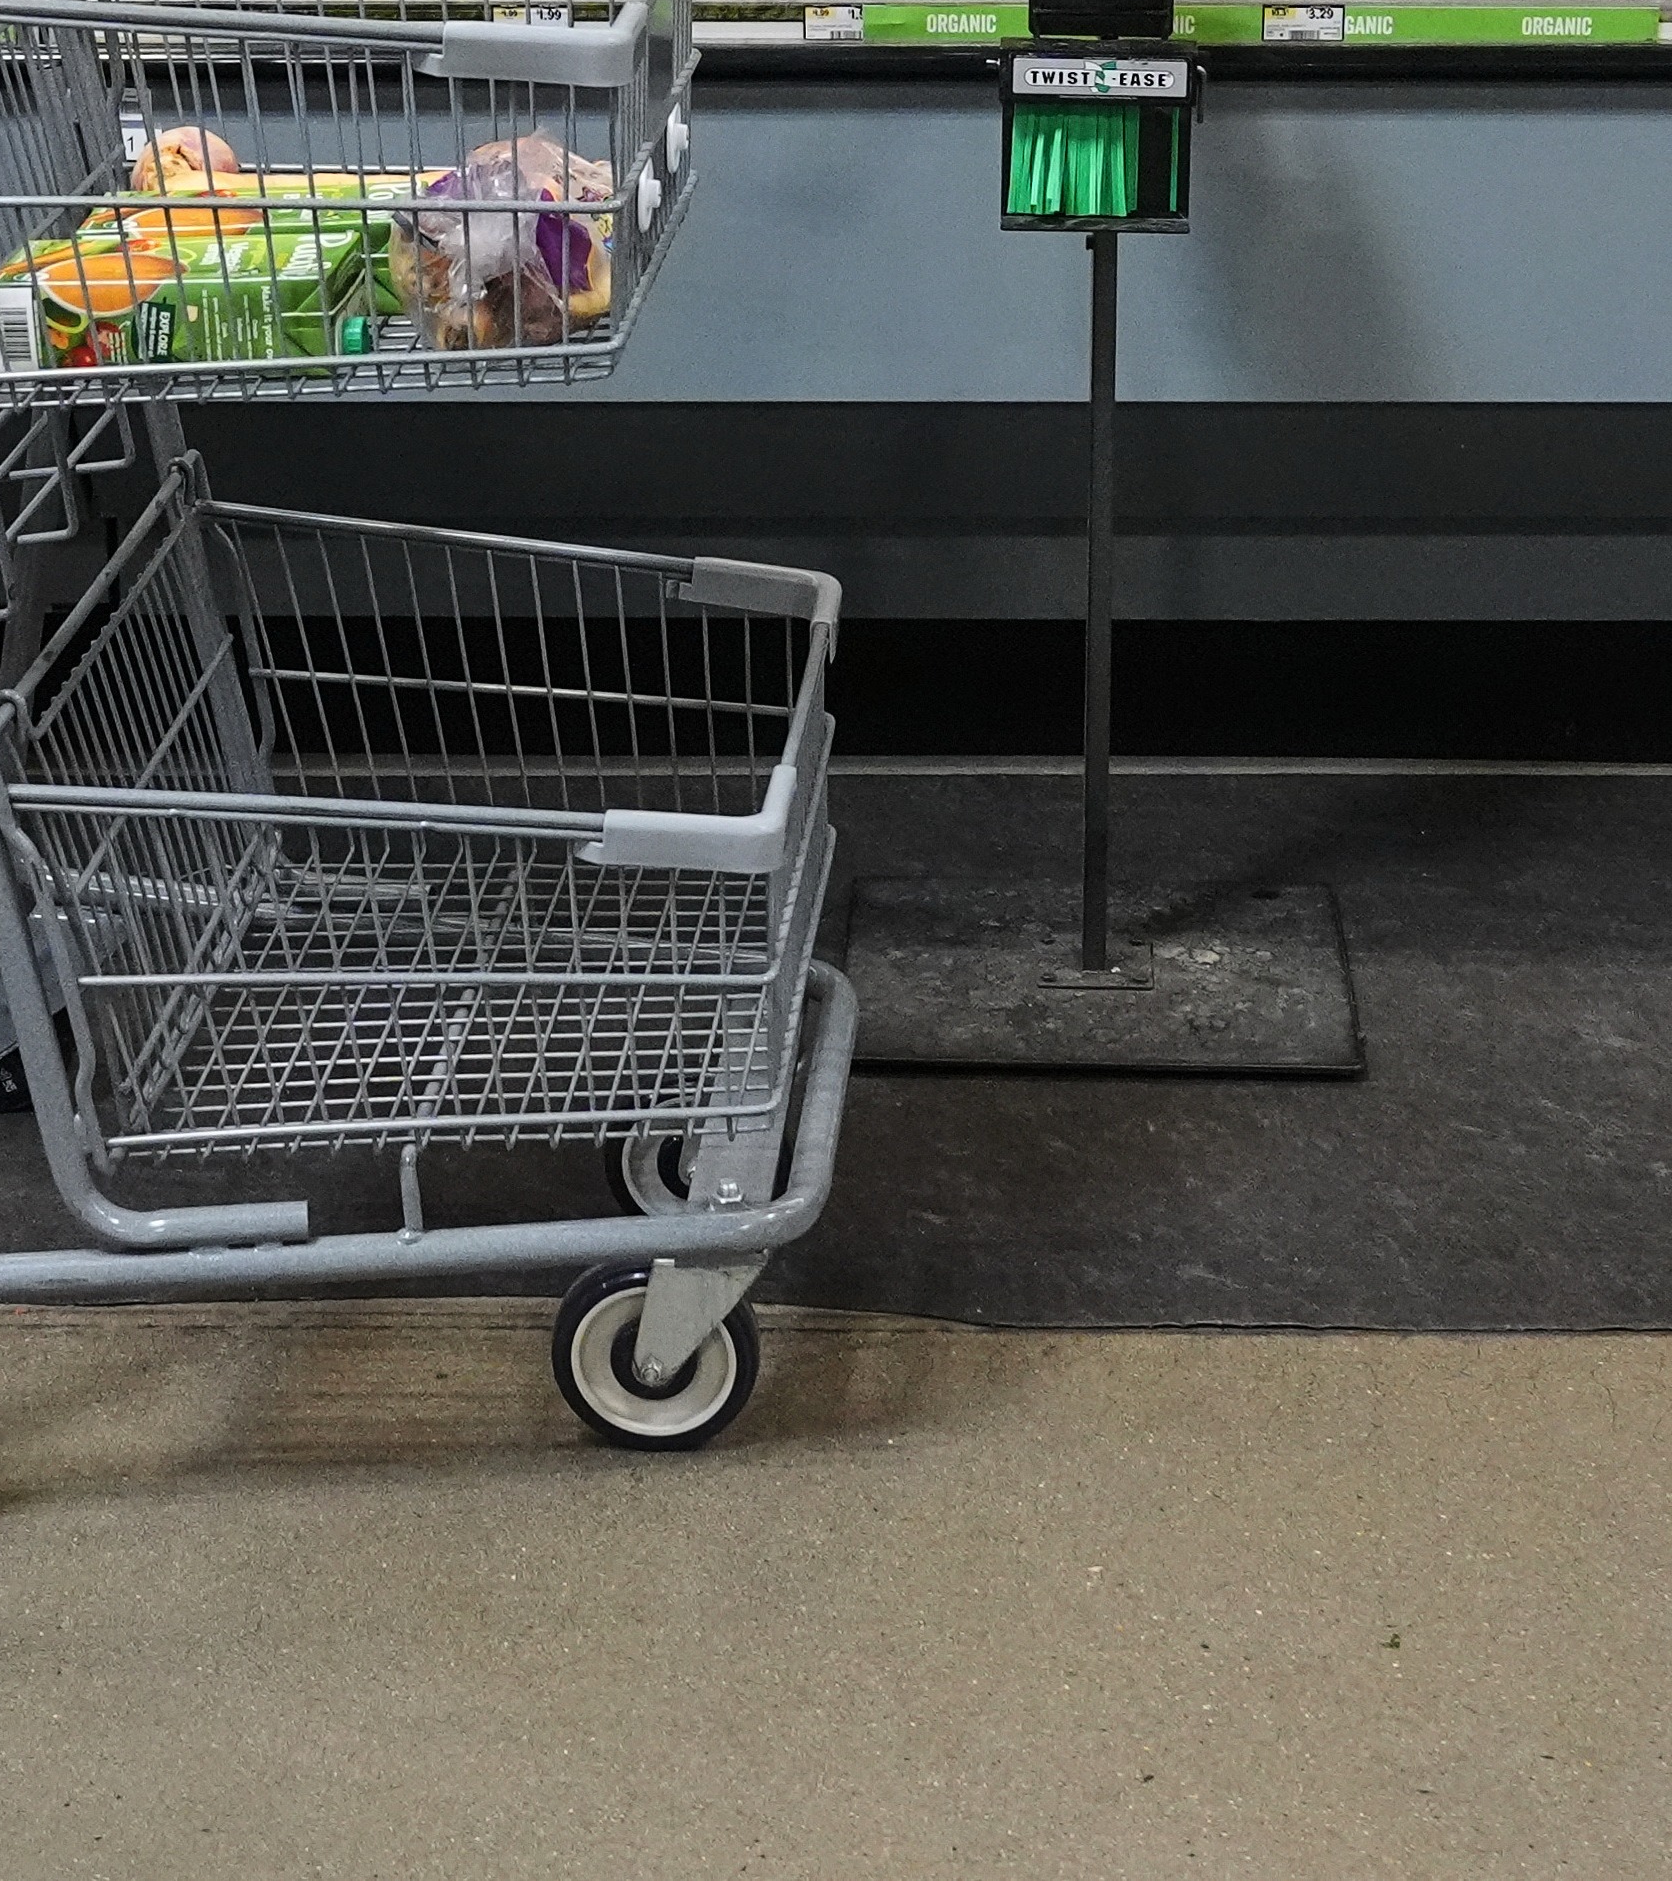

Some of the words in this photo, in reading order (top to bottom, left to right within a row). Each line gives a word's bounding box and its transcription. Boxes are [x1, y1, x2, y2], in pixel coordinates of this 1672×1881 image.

[926, 14, 997, 33] ORGANIC
[1345, 15, 1393, 35] GANIC
[1521, 16, 1593, 36] ORGANIC
[1030, 71, 1090, 85] TWIST
[127, 136, 135, 152] 1
[157, 310, 172, 357] EXPLORE
